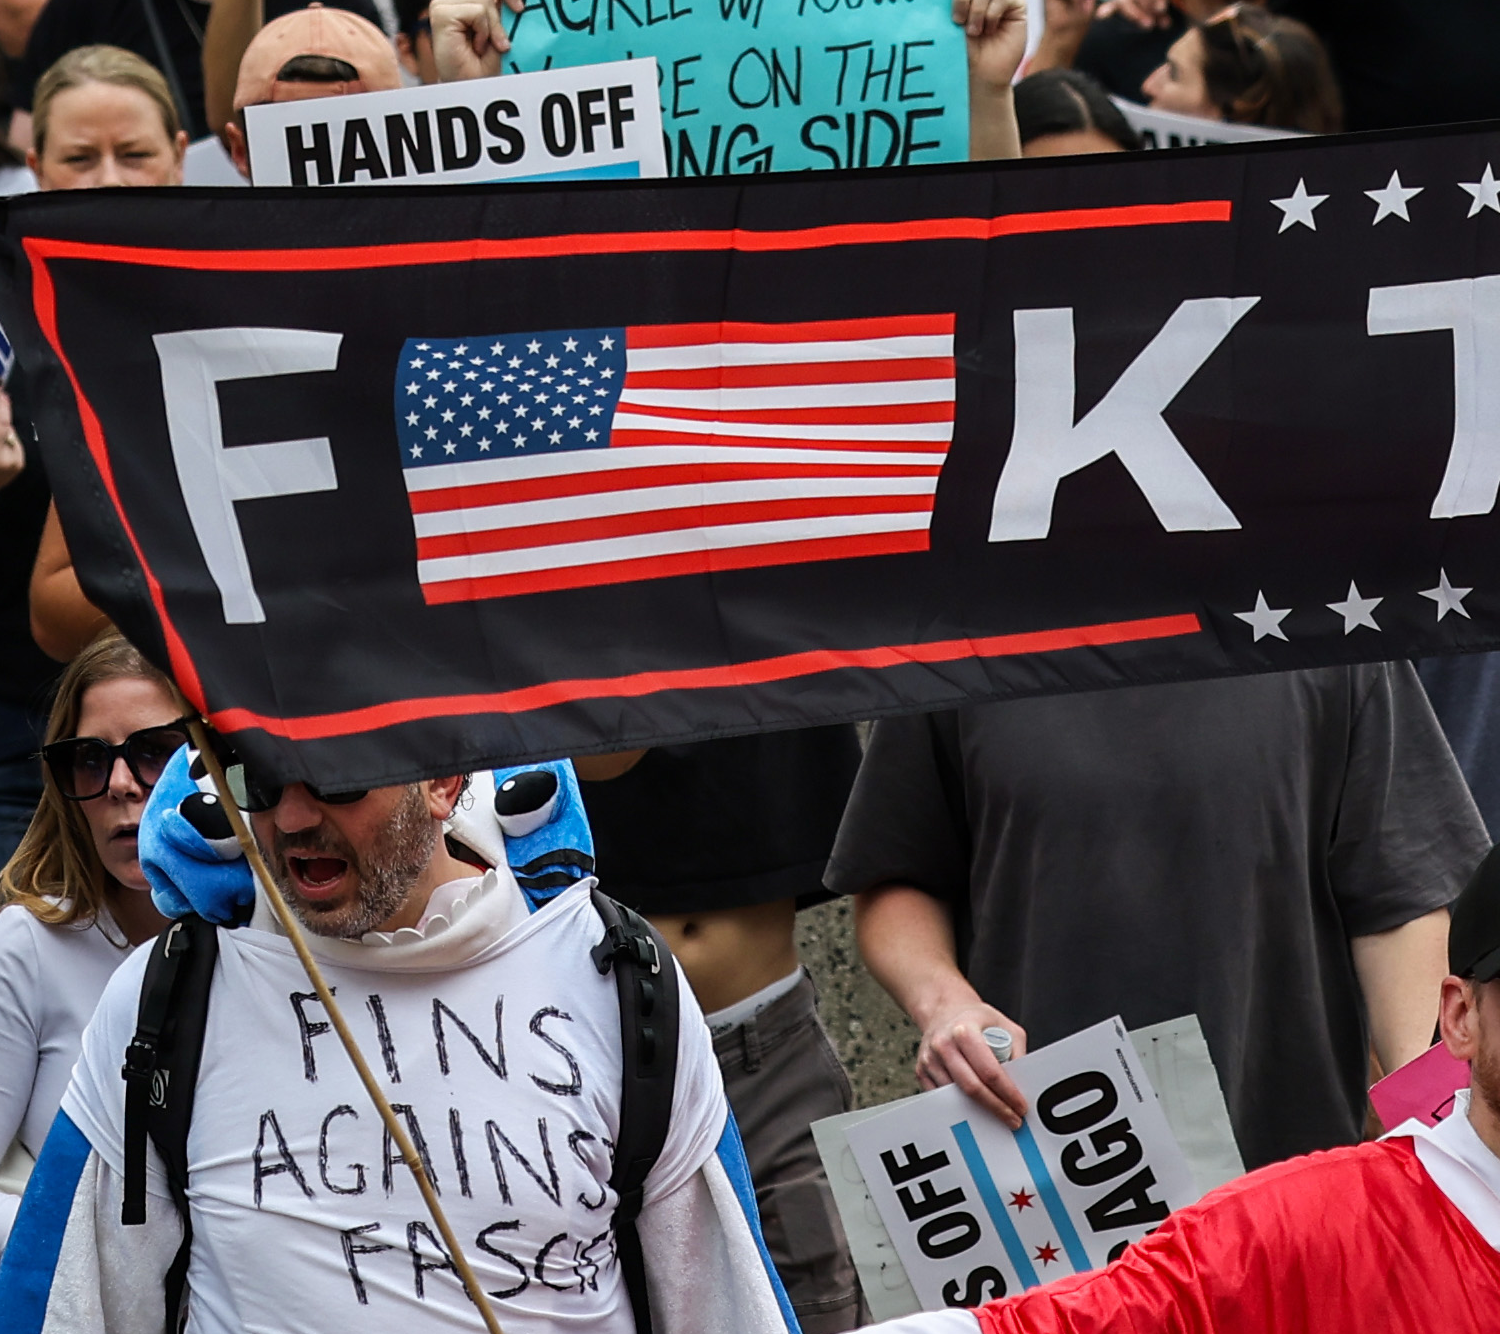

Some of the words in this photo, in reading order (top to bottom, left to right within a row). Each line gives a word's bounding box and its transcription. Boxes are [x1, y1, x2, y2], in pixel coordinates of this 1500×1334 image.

[728, 44, 806, 110] ON
[811, 37, 938, 107] THE
[281, 97, 519, 188] HANDS
[538, 80, 638, 158] OFF
[798, 105, 946, 173] SIDE
[288, 987, 585, 1099] FINS
[252, 1101, 619, 1212] AGAINS
[884, 1142, 985, 1260] OFF
